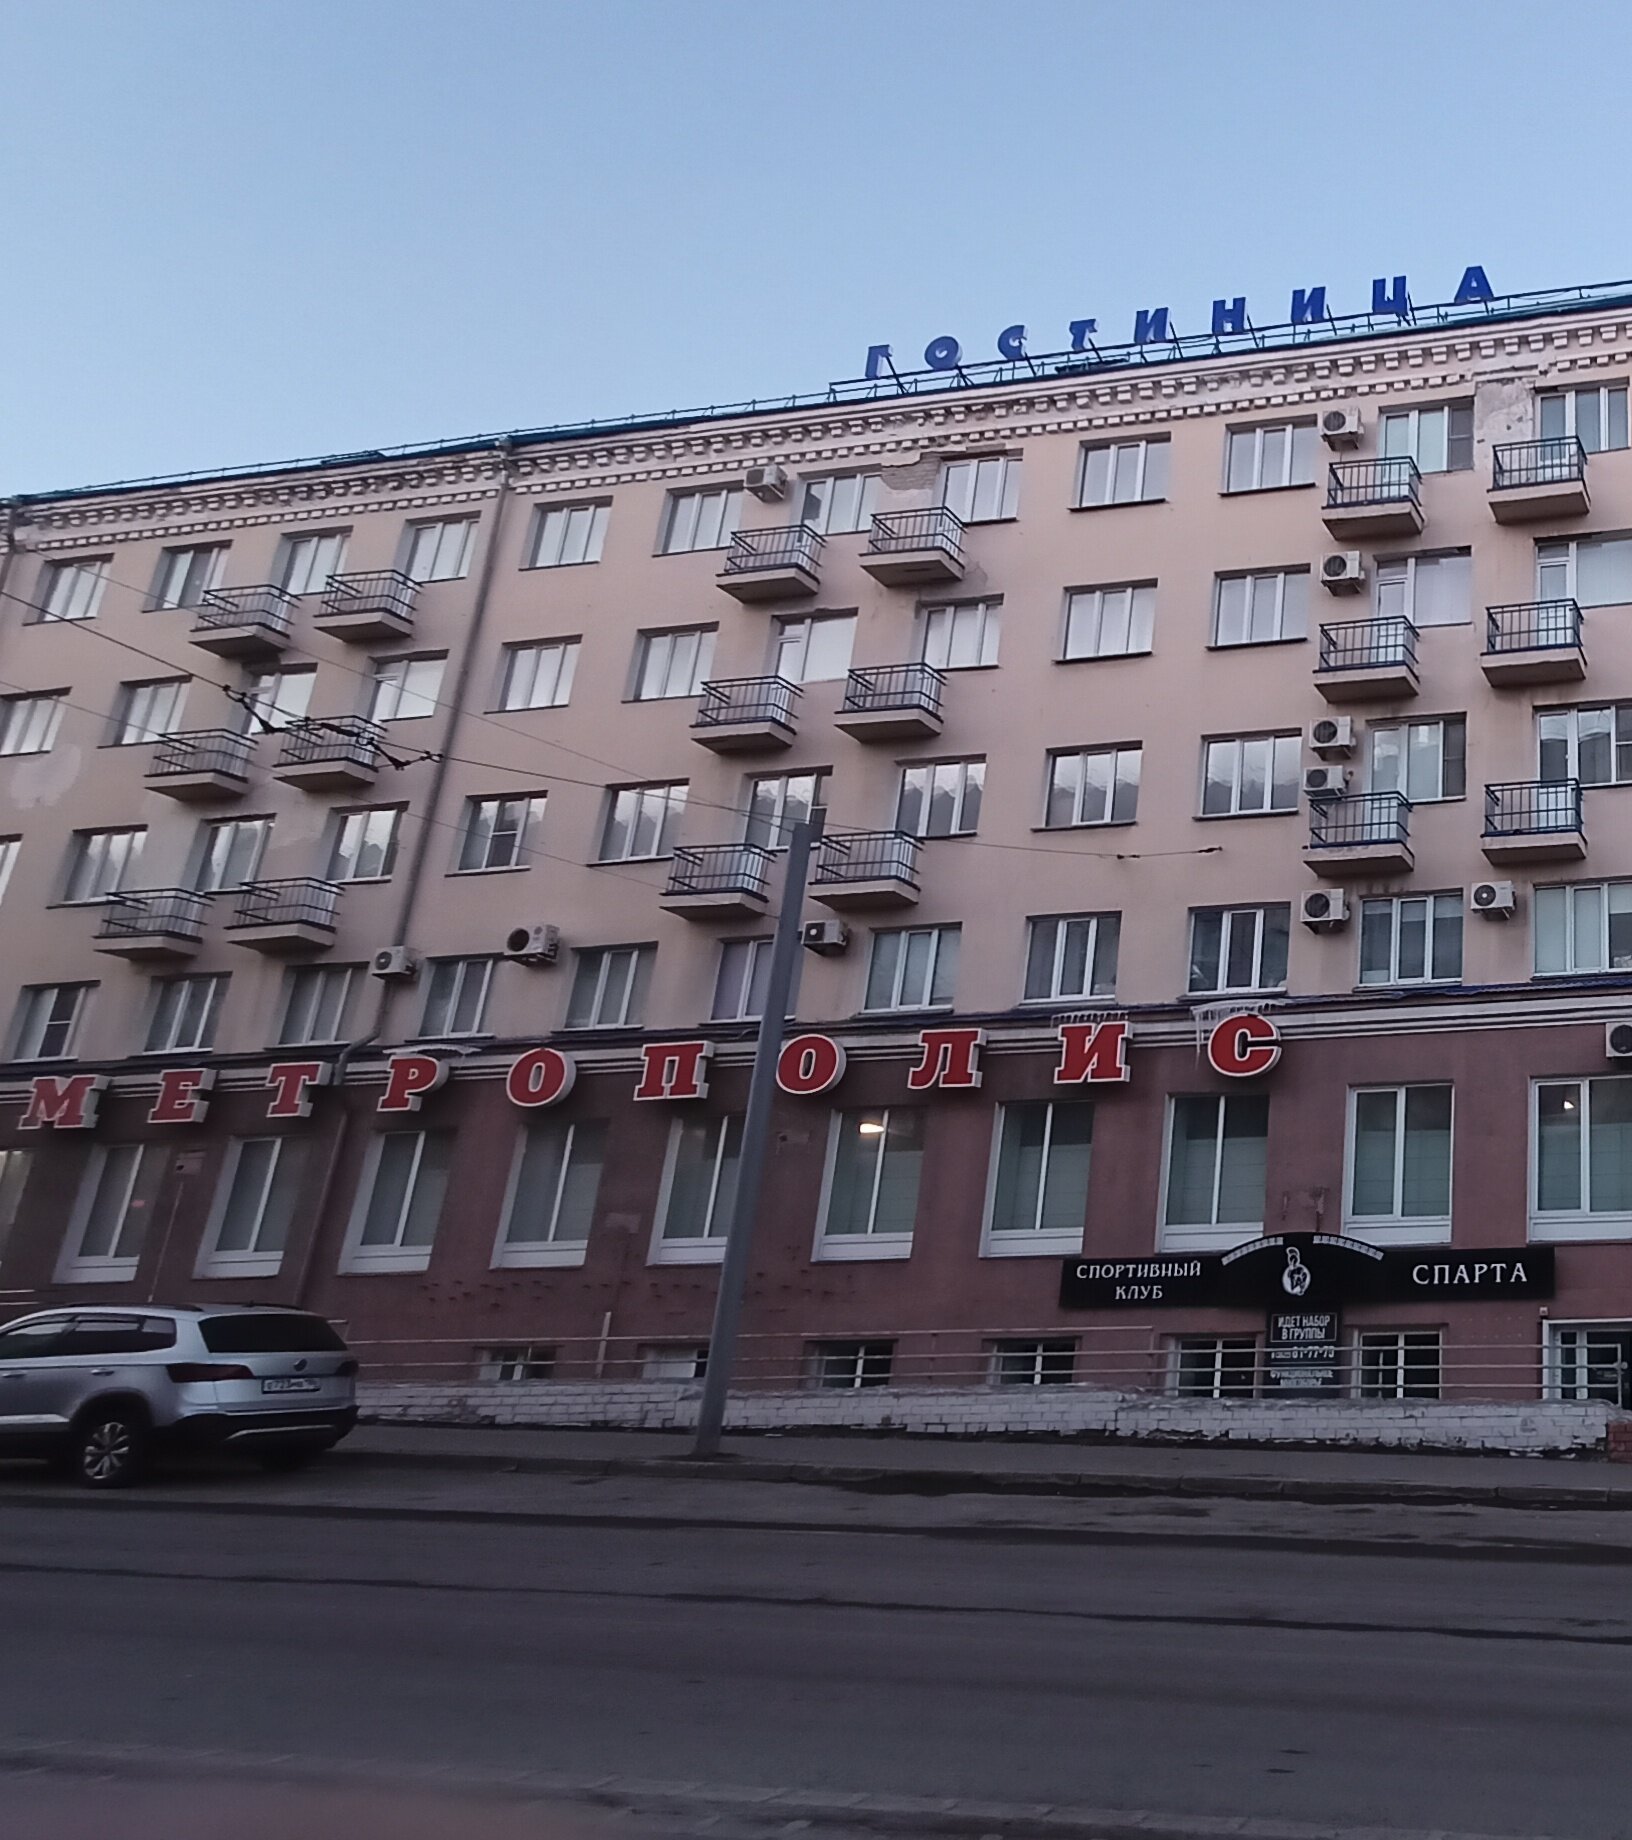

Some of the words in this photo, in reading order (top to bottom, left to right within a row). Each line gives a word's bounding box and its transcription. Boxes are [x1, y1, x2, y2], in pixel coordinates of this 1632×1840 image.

[865, 265, 1496, 379] ГОСТИНИЦА
[17, 1011, 1283, 1130] МЕТРОПОЛИС
[1075, 1261, 1201, 1280] СПОРТИВНЫЙ
[1412, 1261, 1528, 1286] СПАРТА
[1115, 1284, 1163, 1300] КЛУБ
[1302, 1315, 1330, 1327] НАБОР
[1281, 1328, 1288, 1340] В
[1289, 1327, 1325, 1339] ГРУППЫ
